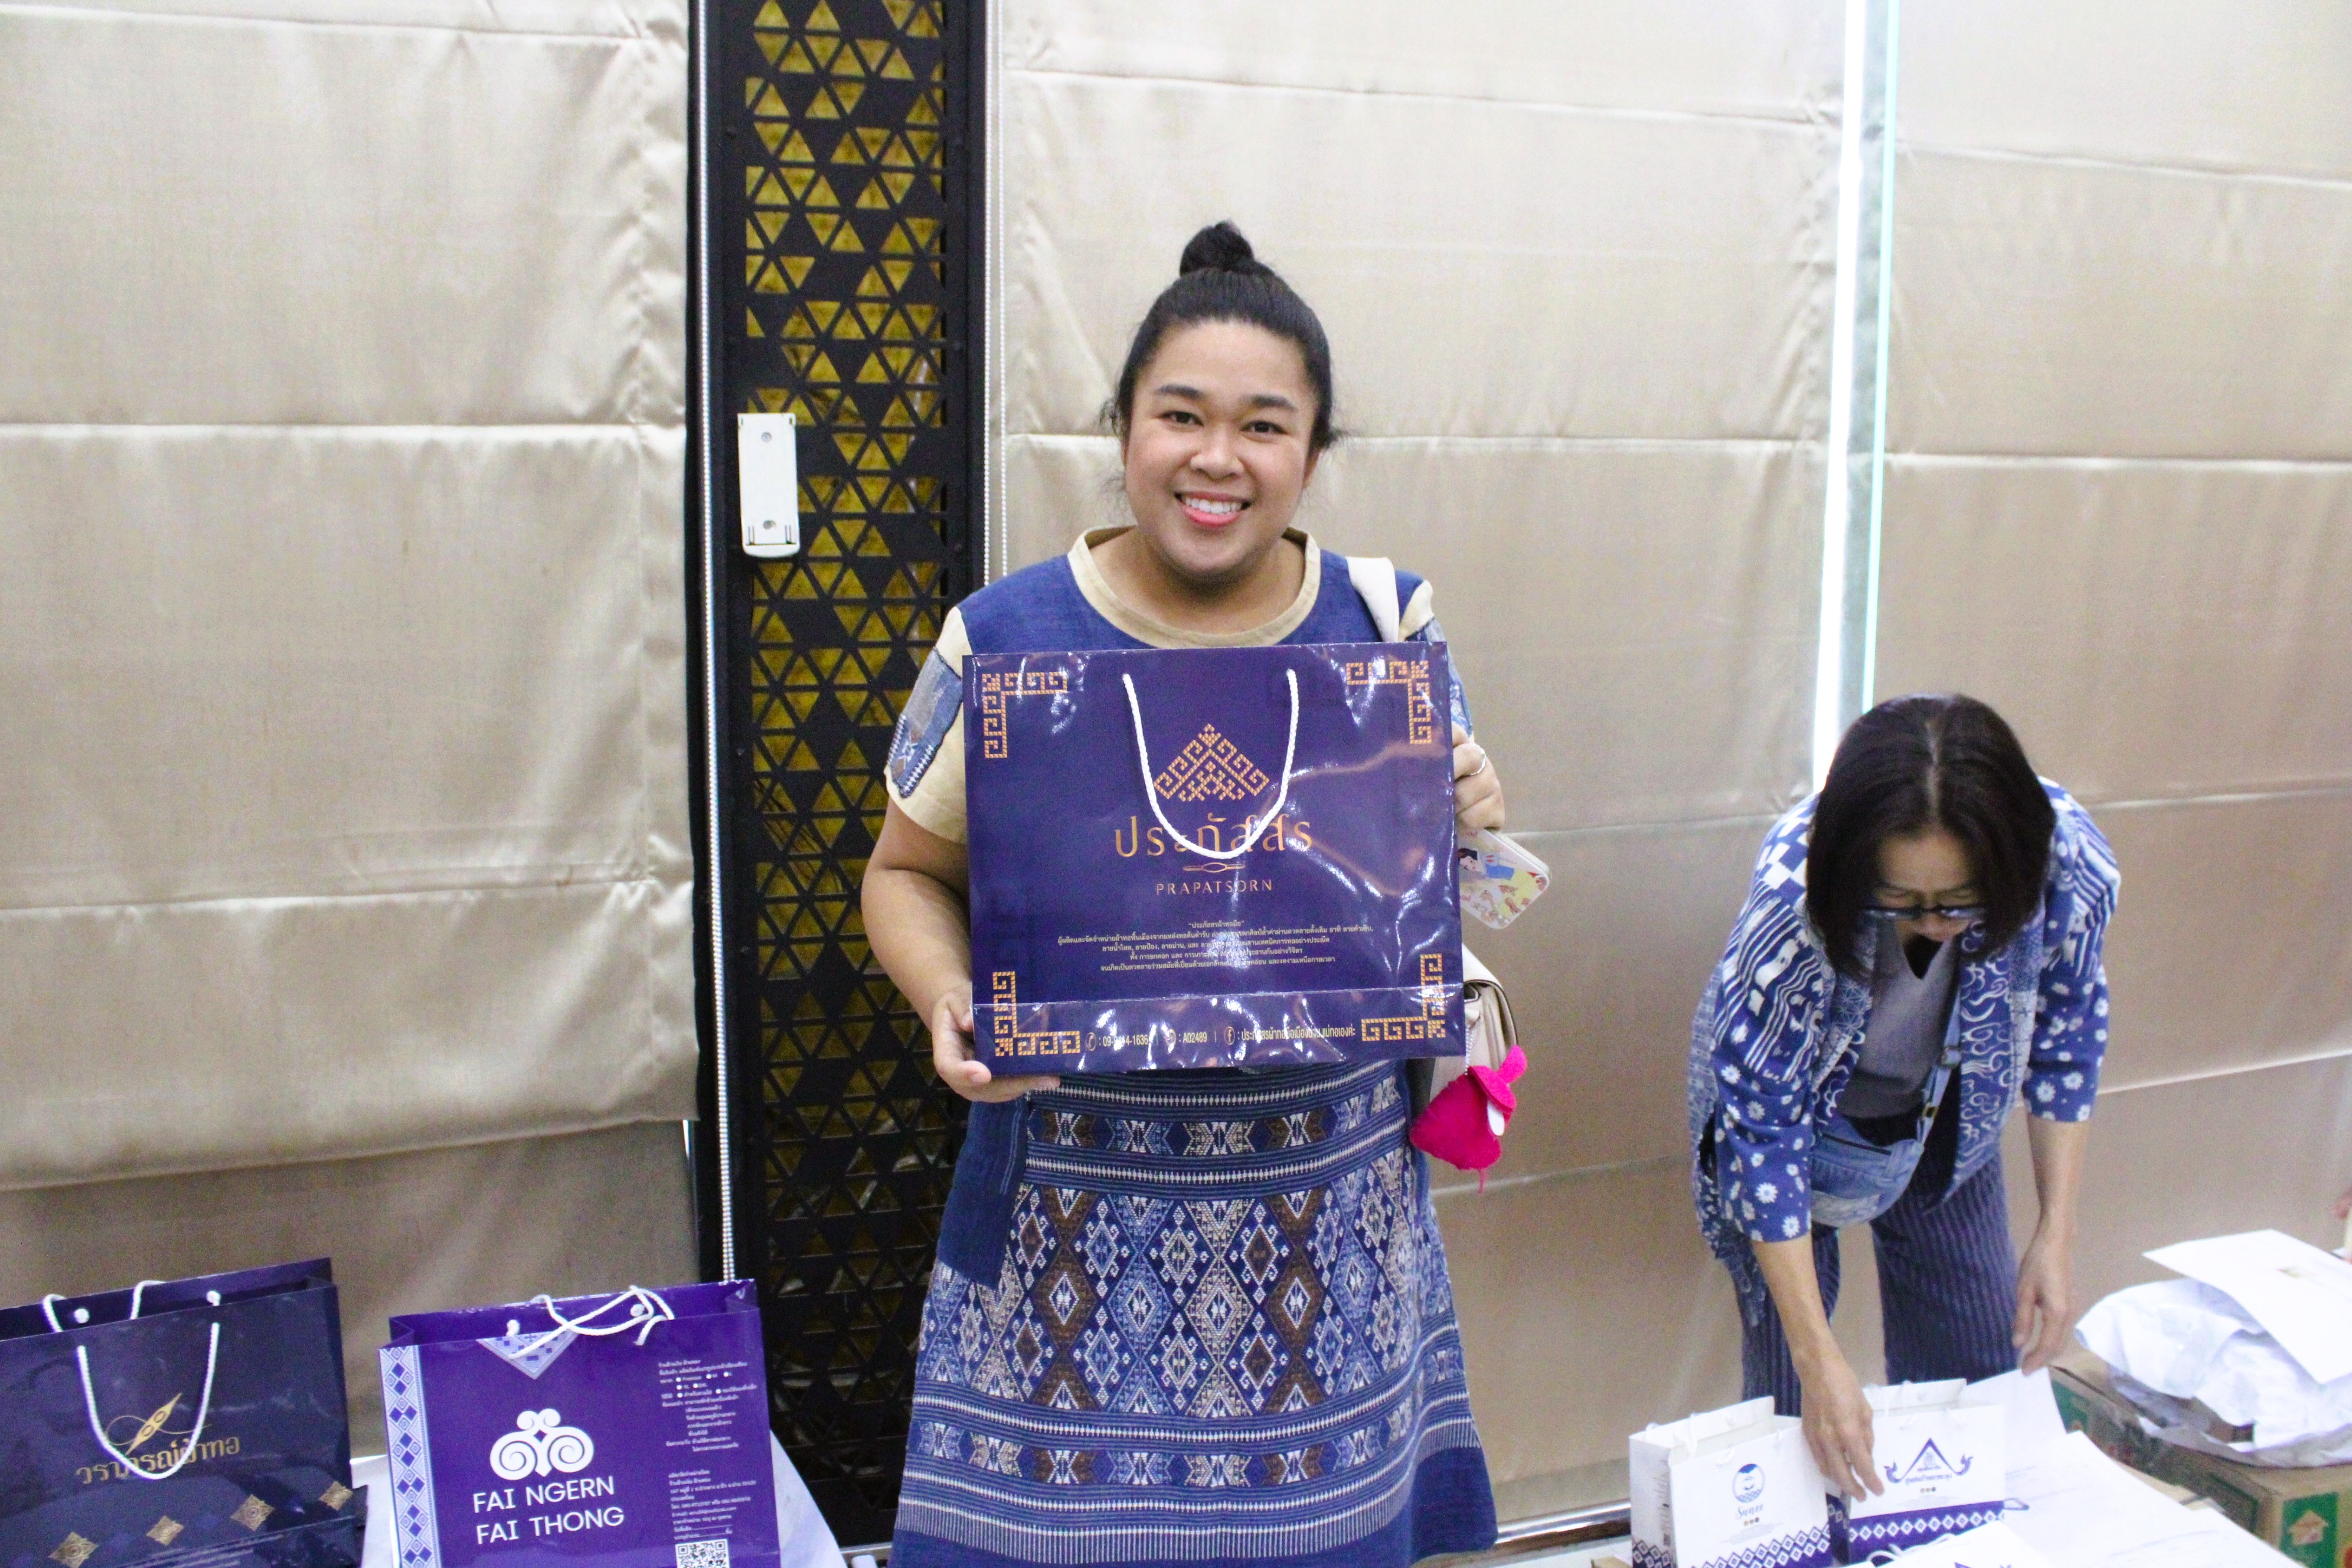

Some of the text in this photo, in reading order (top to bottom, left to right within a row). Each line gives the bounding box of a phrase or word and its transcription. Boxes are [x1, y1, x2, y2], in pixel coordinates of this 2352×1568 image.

[1115, 812, 1312, 857] ประภัสสร
[1156, 879, 1273, 896] PRAPATSORN
[1103, 1034, 1148, 1047] 09-4-1636
[1183, 1032, 1207, 1044] A02489
[473, 1475, 615, 1514] FAI NGERN
[476, 1507, 625, 1545] FAI THONG
